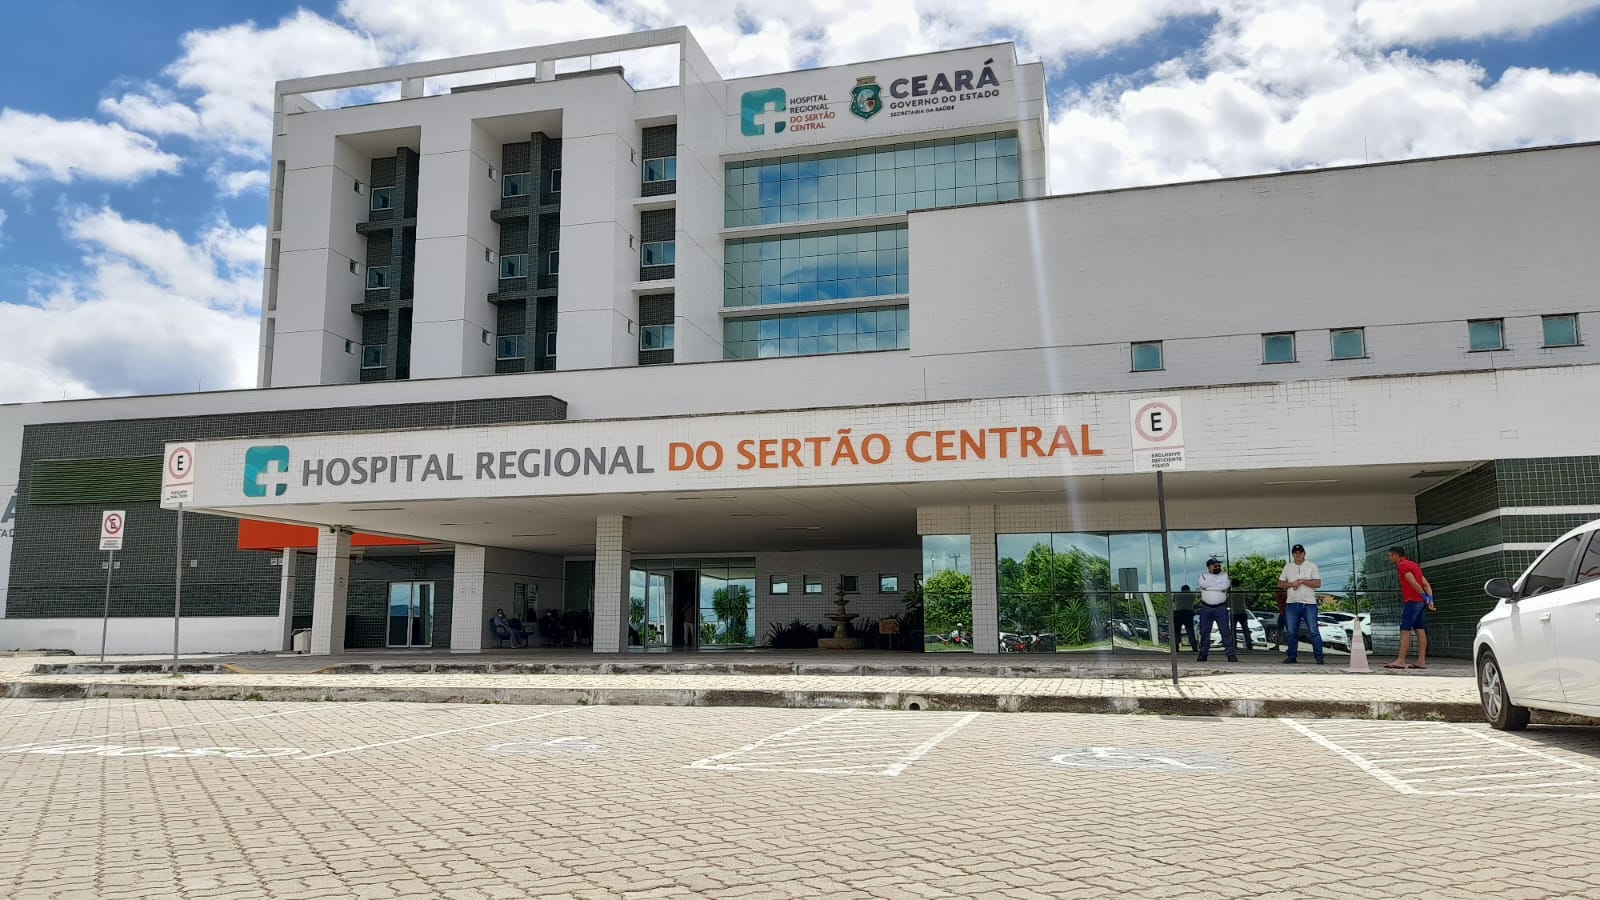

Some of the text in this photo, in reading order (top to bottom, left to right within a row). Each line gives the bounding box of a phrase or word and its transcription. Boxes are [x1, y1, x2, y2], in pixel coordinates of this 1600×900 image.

[889, 57, 1000, 99] CEARÁ
[790, 93, 828, 105] HOSPITAL
[889, 89, 1000, 109] GOVERNO DO ESTADO
[790, 103, 829, 114] REGIONAL
[890, 109, 924, 118] SECRETARIA
[935, 104, 955, 112] SAÚDE
[790, 110, 836, 123] DO SERTÃO
[790, 122, 827, 132] CENTRAL
[1150, 412, 1163, 432] E
[177, 455, 184, 471] E
[302, 424, 1104, 487] HOSPITAL REGIONAL DO SERTÃO CENTRAL
